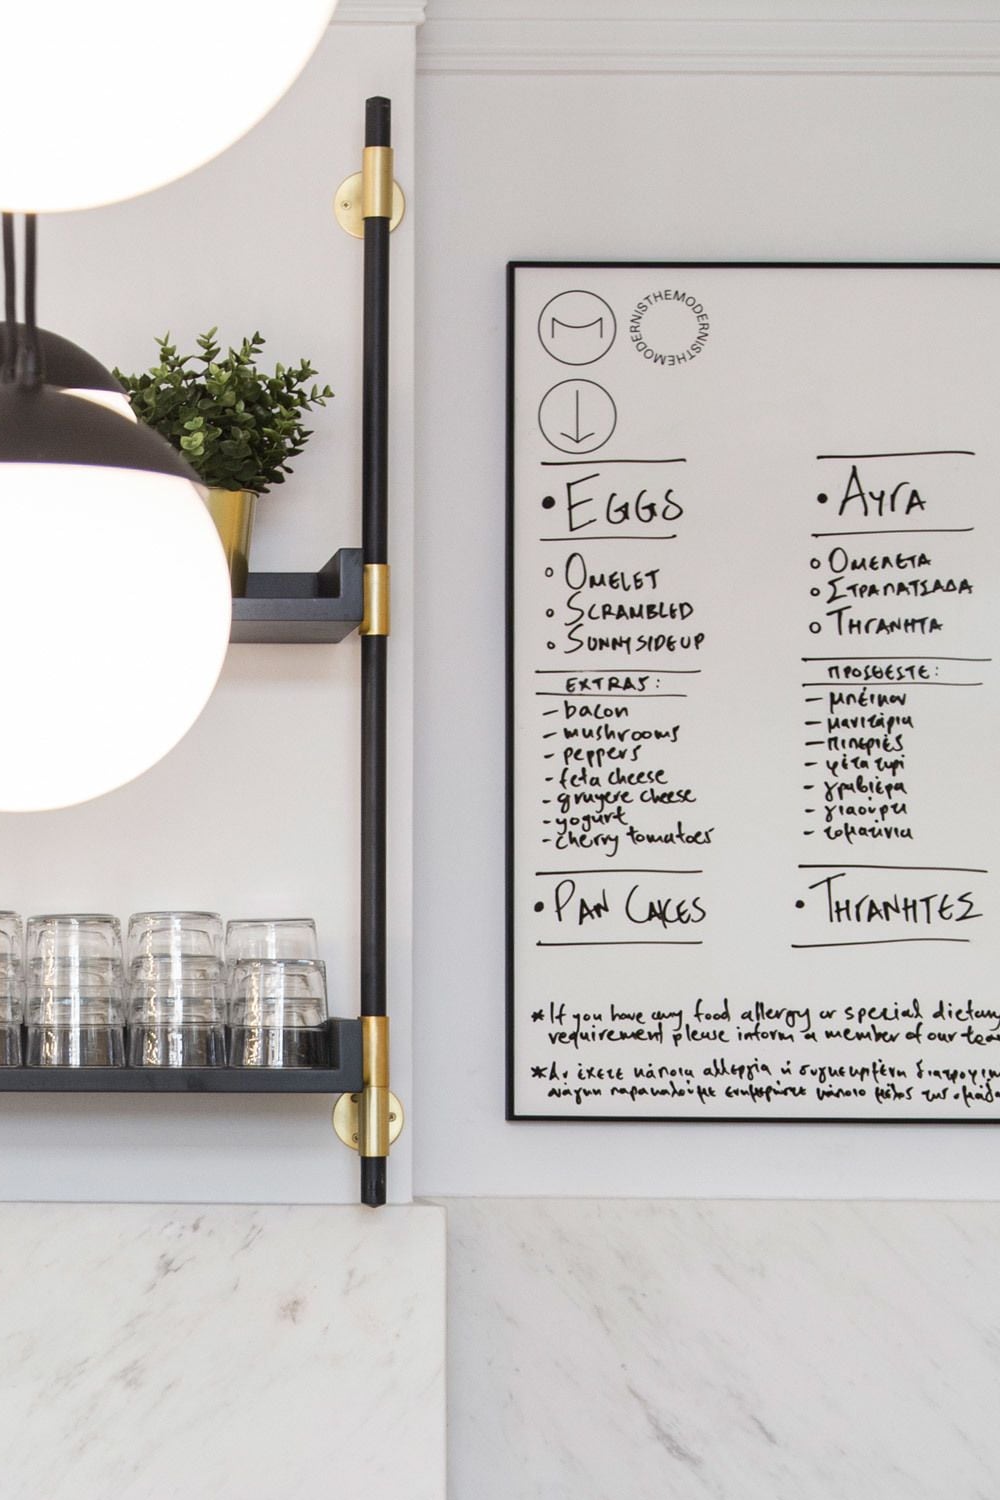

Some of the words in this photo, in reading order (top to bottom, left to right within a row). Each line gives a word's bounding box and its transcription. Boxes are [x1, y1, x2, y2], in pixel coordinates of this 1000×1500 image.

[565, 472, 684, 532] EGGS
[564, 552, 661, 590] OMELET
[564, 590, 695, 626] SCRAMBLED
[564, 700, 629, 720] bacon
[563, 723, 680, 743] mushrooms
[563, 745, 642, 768] peppers
[559, 767, 602, 790] feta
[608, 767, 669, 786] cheese
[556, 791, 635, 814] gruyere
[640, 788, 698, 805] cheese
[555, 805, 629, 835] yogurt
[555, 831, 619, 858] cherry
[626, 821, 715, 845] tomatoes
[572, 1012, 603, 1032] you
[610, 1003, 646, 1025] have
[693, 997, 731, 1023] food
[740, 1001, 811, 1033] allergy
[843, 997, 924, 1024] special
[672, 1023, 730, 1047] please
[736, 1022, 795, 1043] inform
[804, 1031, 818, 1043] a
[824, 1023, 902, 1043] member
[927, 1032, 958, 1044] our
